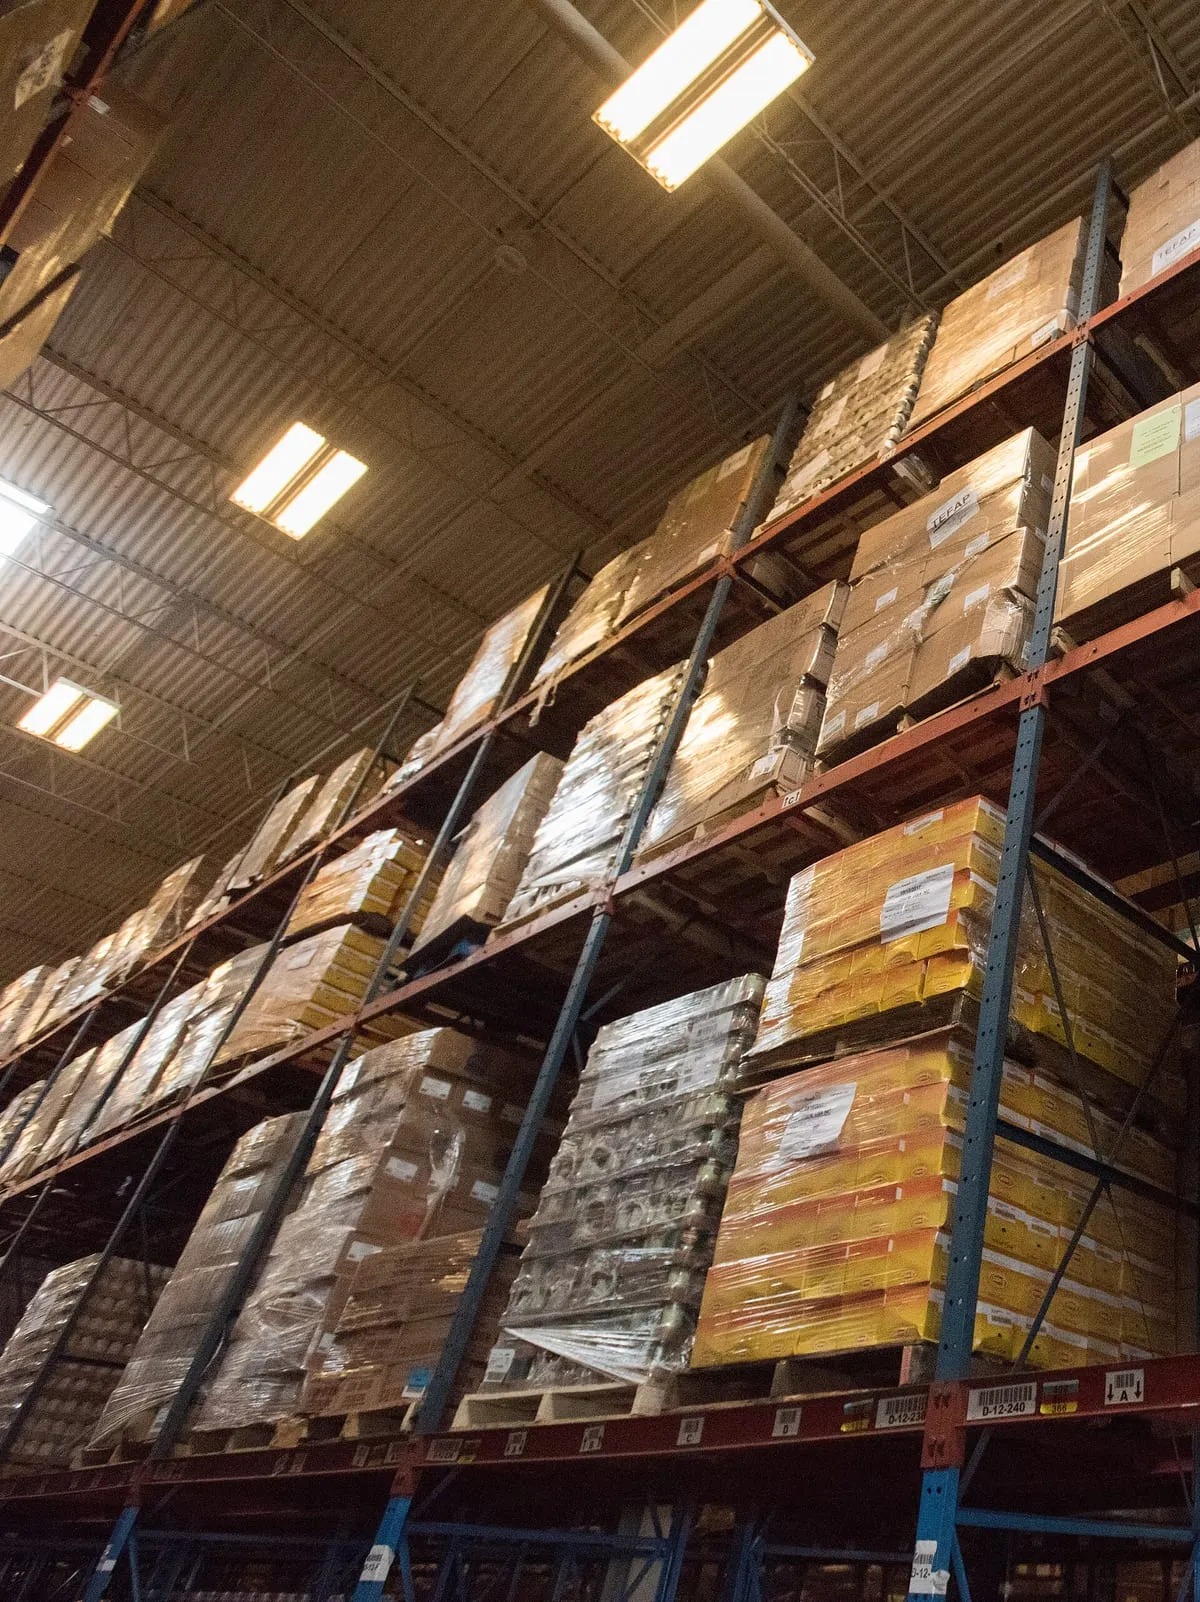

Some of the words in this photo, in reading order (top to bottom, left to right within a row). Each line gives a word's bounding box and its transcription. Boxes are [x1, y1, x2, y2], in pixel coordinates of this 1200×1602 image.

[932, 494, 970, 528] TEFAP
[1120, 1390, 1128, 1401] A
[982, 1402, 1026, 1416] D-12-240
[782, 1425, 789, 1434] D
